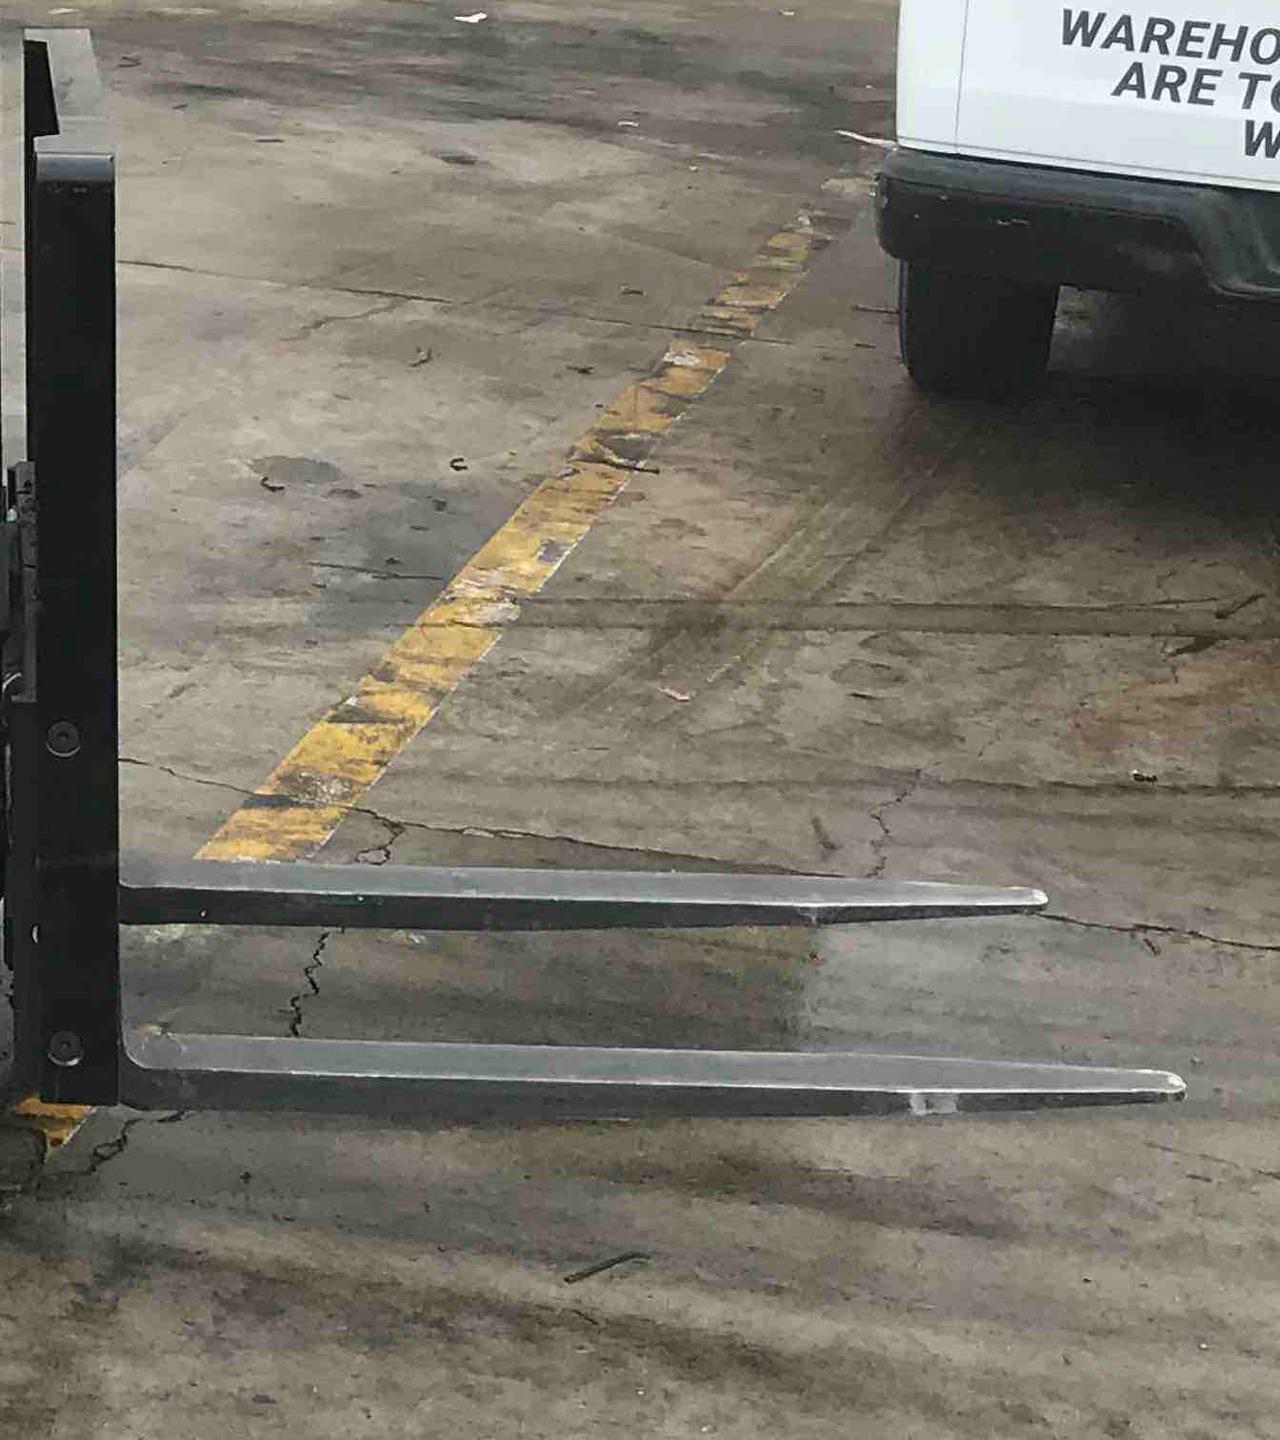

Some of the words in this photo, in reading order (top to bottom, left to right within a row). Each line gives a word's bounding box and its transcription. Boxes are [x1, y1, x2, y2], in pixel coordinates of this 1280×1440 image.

[1061, 8, 1280, 66] WAREHO
[1110, 60, 1224, 107] ARE
[1239, 72, 1280, 114] T
